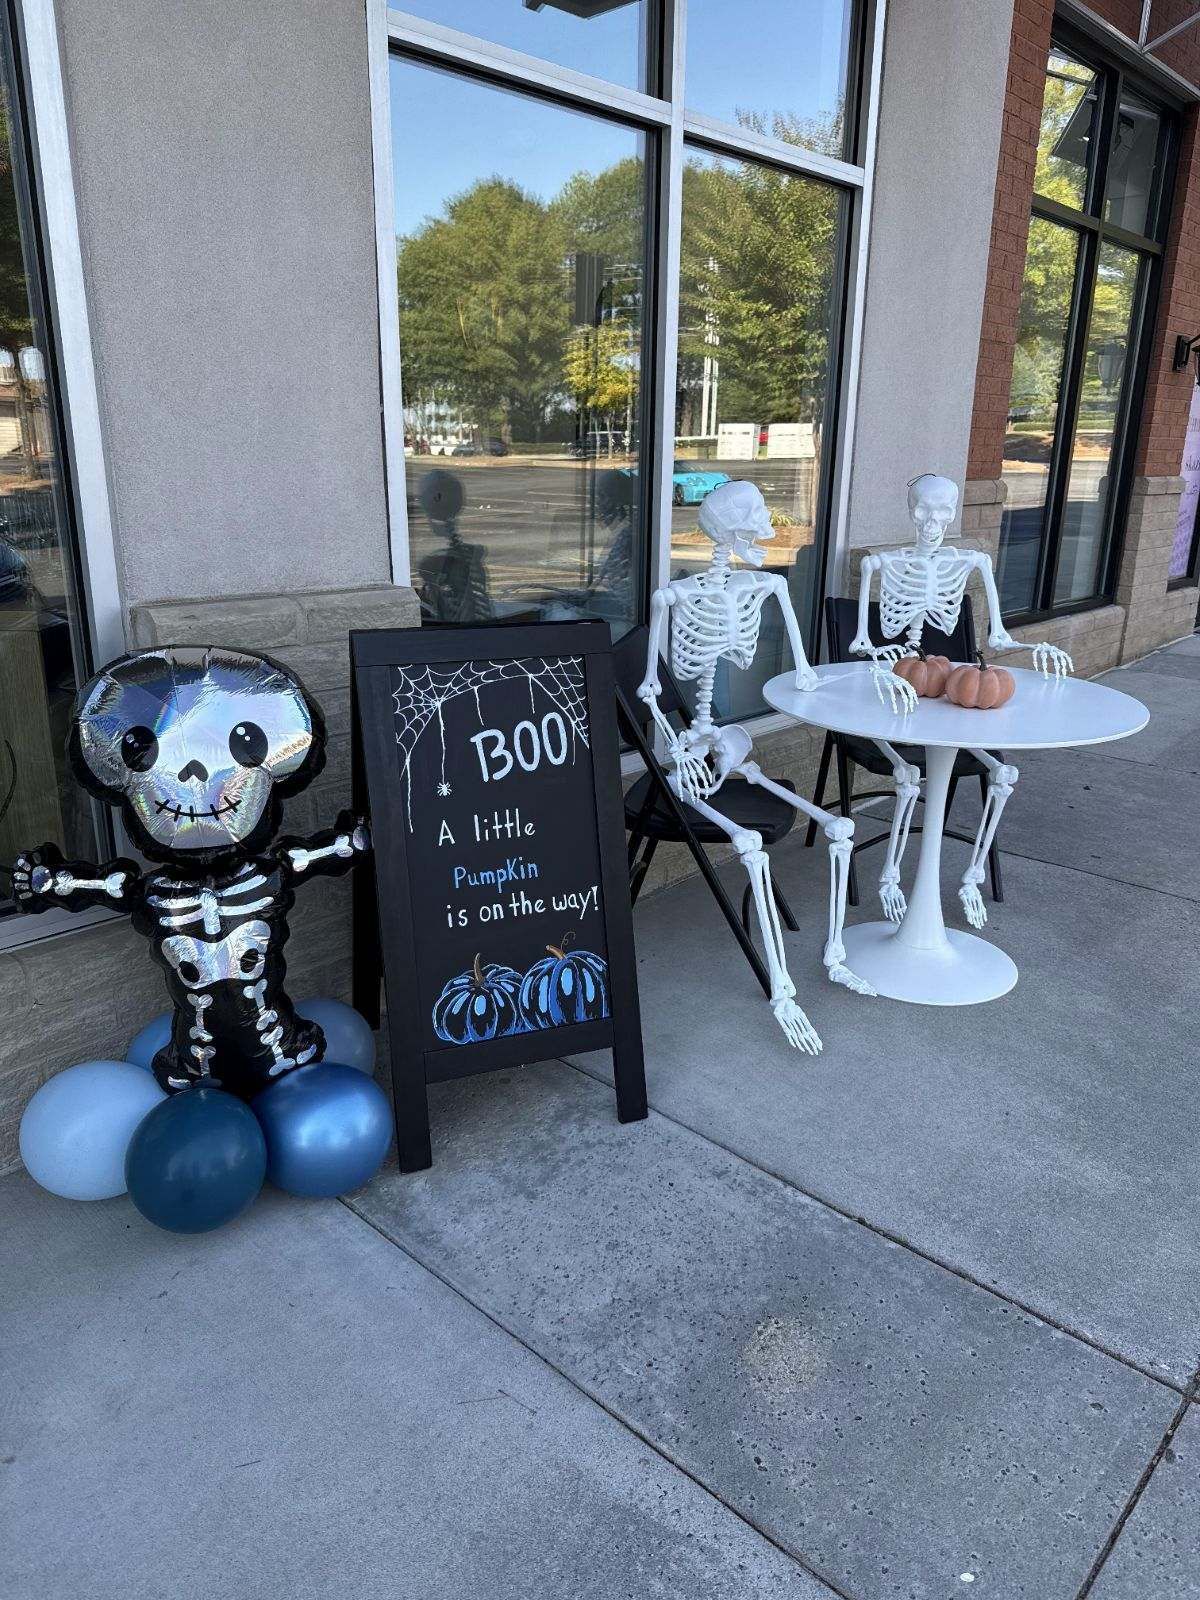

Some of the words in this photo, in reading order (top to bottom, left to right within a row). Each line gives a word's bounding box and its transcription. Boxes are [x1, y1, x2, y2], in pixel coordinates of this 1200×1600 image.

[470, 712, 568, 782] BOO
[438, 819, 456, 846] A
[474, 808, 536, 842] little
[446, 904, 469, 928] is
[479, 902, 504, 922] on
[509, 890, 546, 917] the
[552, 885, 600, 920] way!
